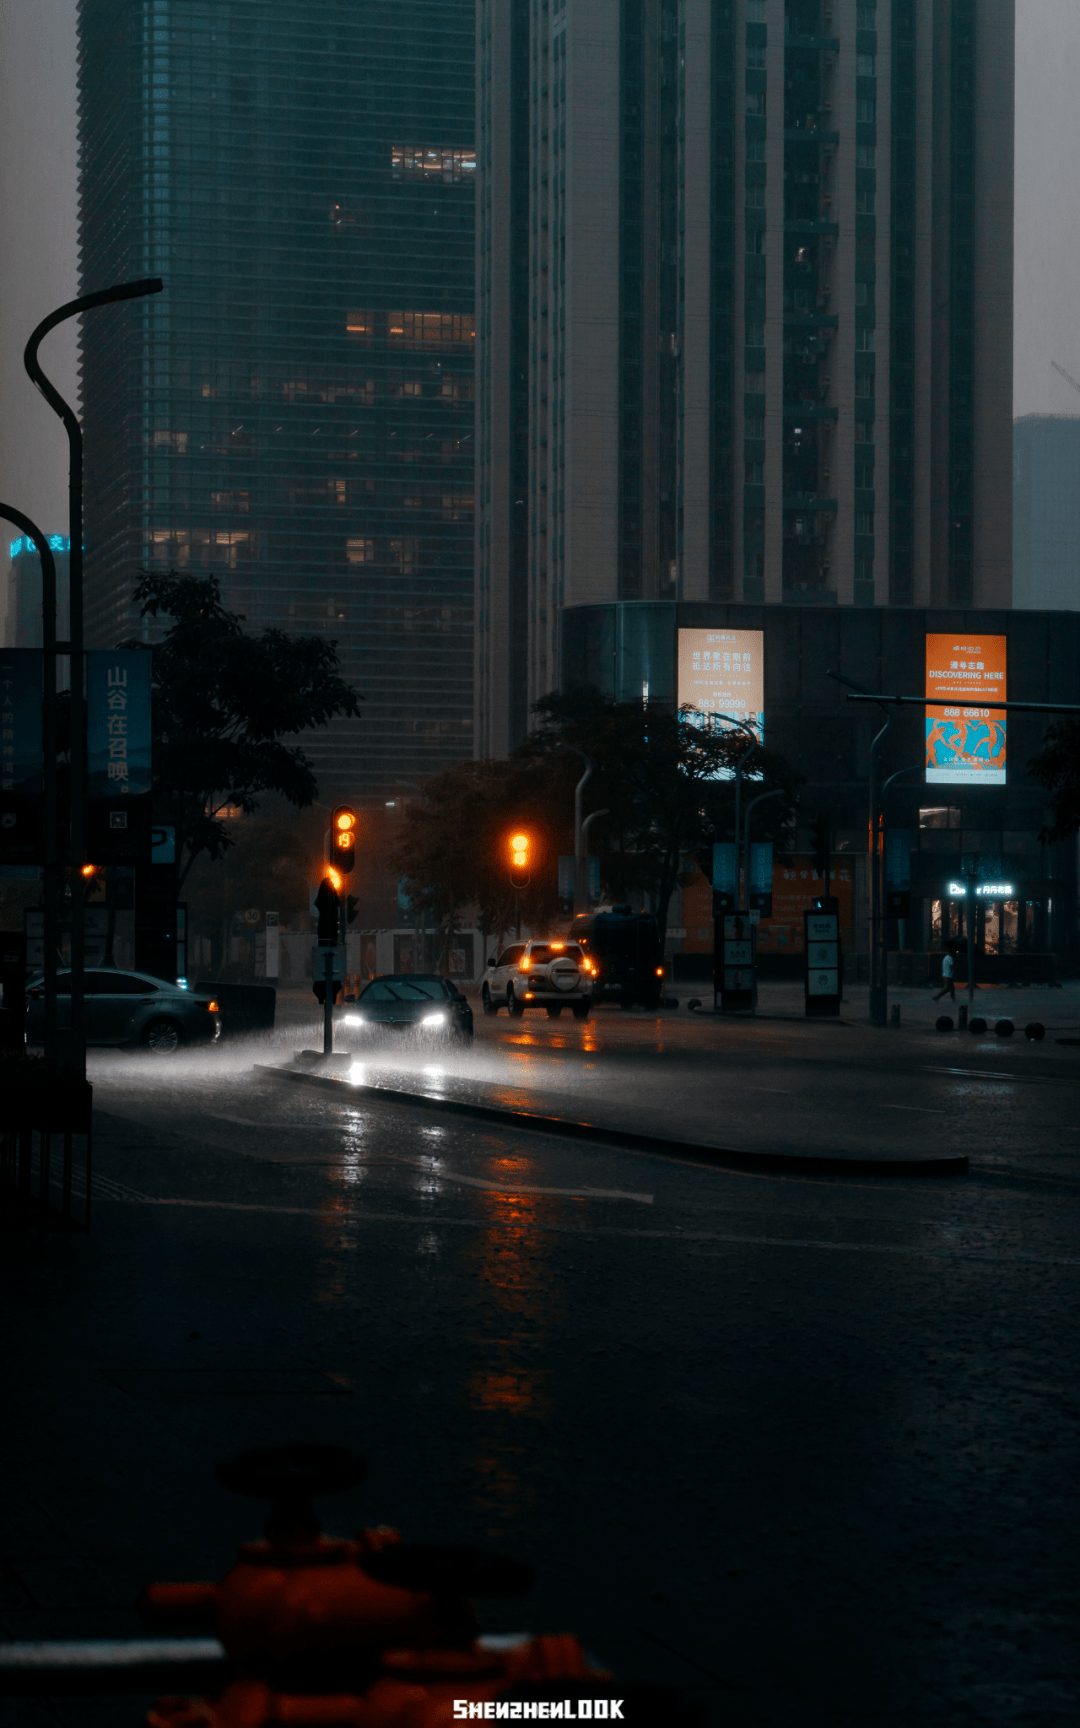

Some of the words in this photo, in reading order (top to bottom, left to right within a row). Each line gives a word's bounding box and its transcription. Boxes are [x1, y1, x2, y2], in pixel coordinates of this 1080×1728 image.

[929, 671, 981, 680] DISCOVERING
[698, 699, 716, 709] 883
[719, 699, 747, 709] 99999
[944, 708, 960, 717] 888
[963, 709, 990, 717] 66610
[338, 831, 350, 848] 19
[246, 910, 259, 922] 30
[269, 915, 277, 925] P
